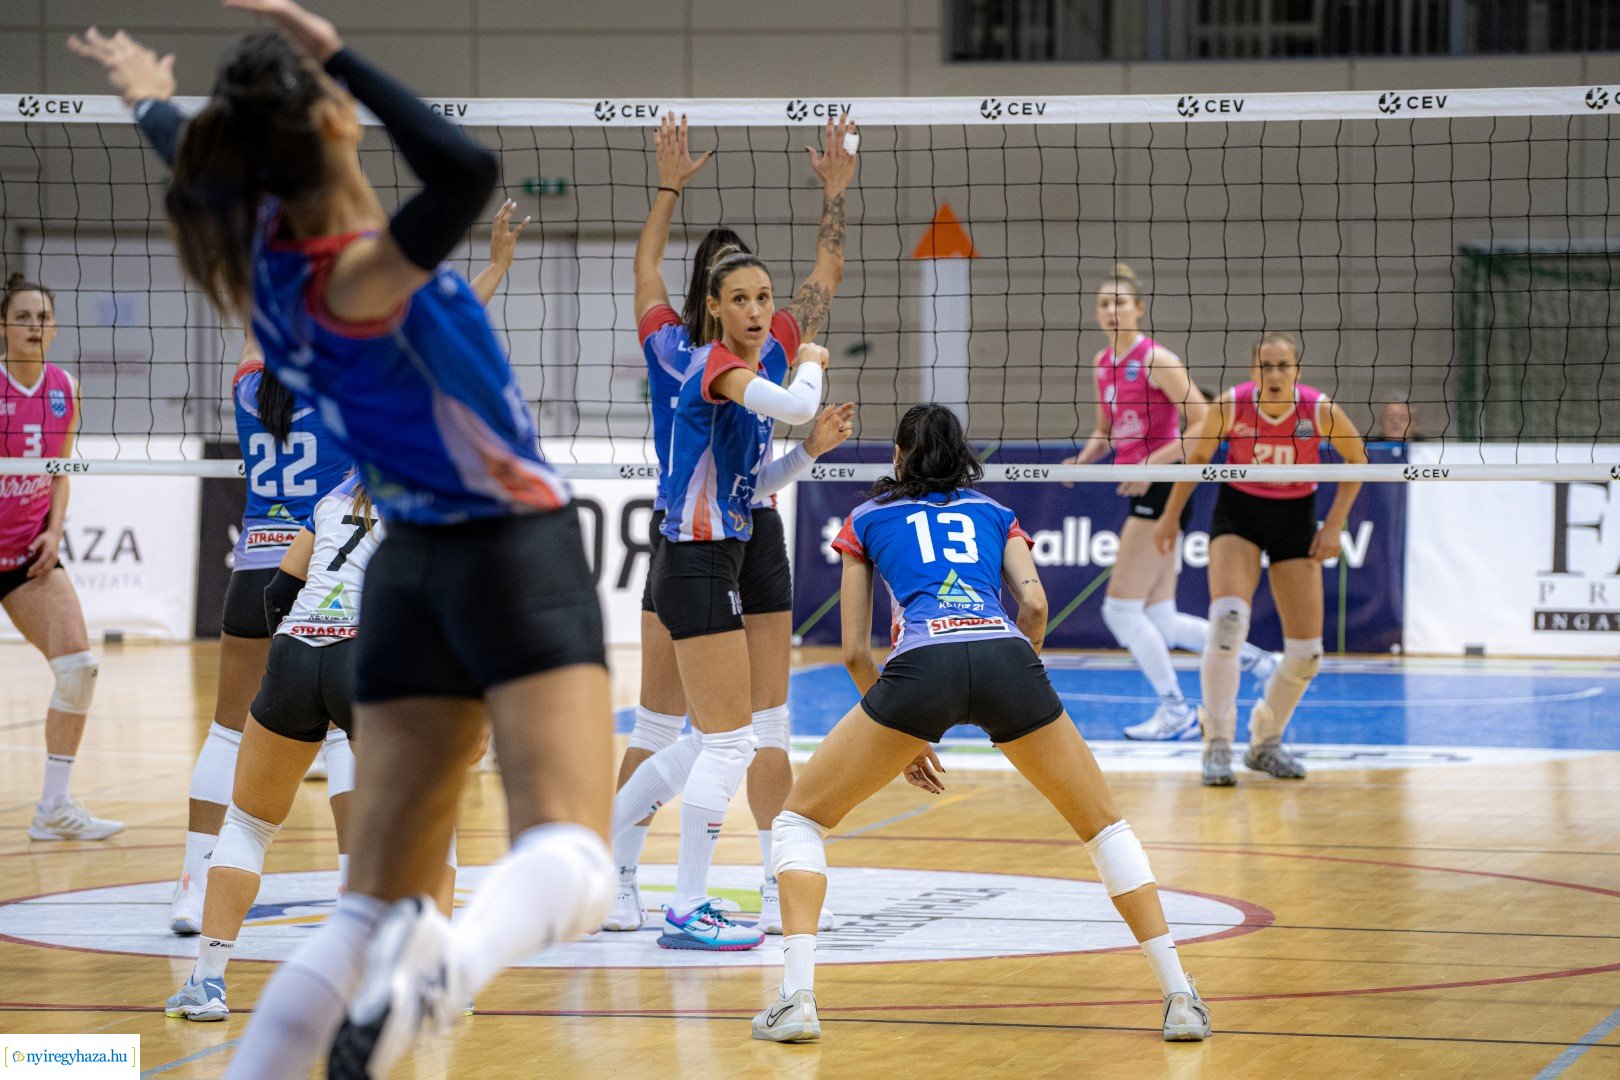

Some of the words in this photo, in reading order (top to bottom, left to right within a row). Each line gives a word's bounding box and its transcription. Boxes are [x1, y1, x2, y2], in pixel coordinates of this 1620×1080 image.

[46, 101, 84, 114] CEV
[1007, 102, 1047, 116] CEV
[1205, 99, 1245, 113] CEV
[1407, 95, 1448, 110] CEV
[431, 103, 468, 117] CEV
[621, 104, 659, 118] CEV
[813, 103, 851, 118] CEV
[23, 424, 42, 458] 3
[1252, 443, 1294, 464] 20
[63, 463, 90, 474] CEV
[249, 431, 318, 498] 22
[829, 468, 855, 478] CEV
[1023, 468, 1050, 478] CEV
[1220, 469, 1247, 479] CEV
[1422, 469, 1450, 478] CEV
[247, 533, 298, 544] STRABA
[327, 514, 379, 572] 7
[906, 510, 979, 564] 13
